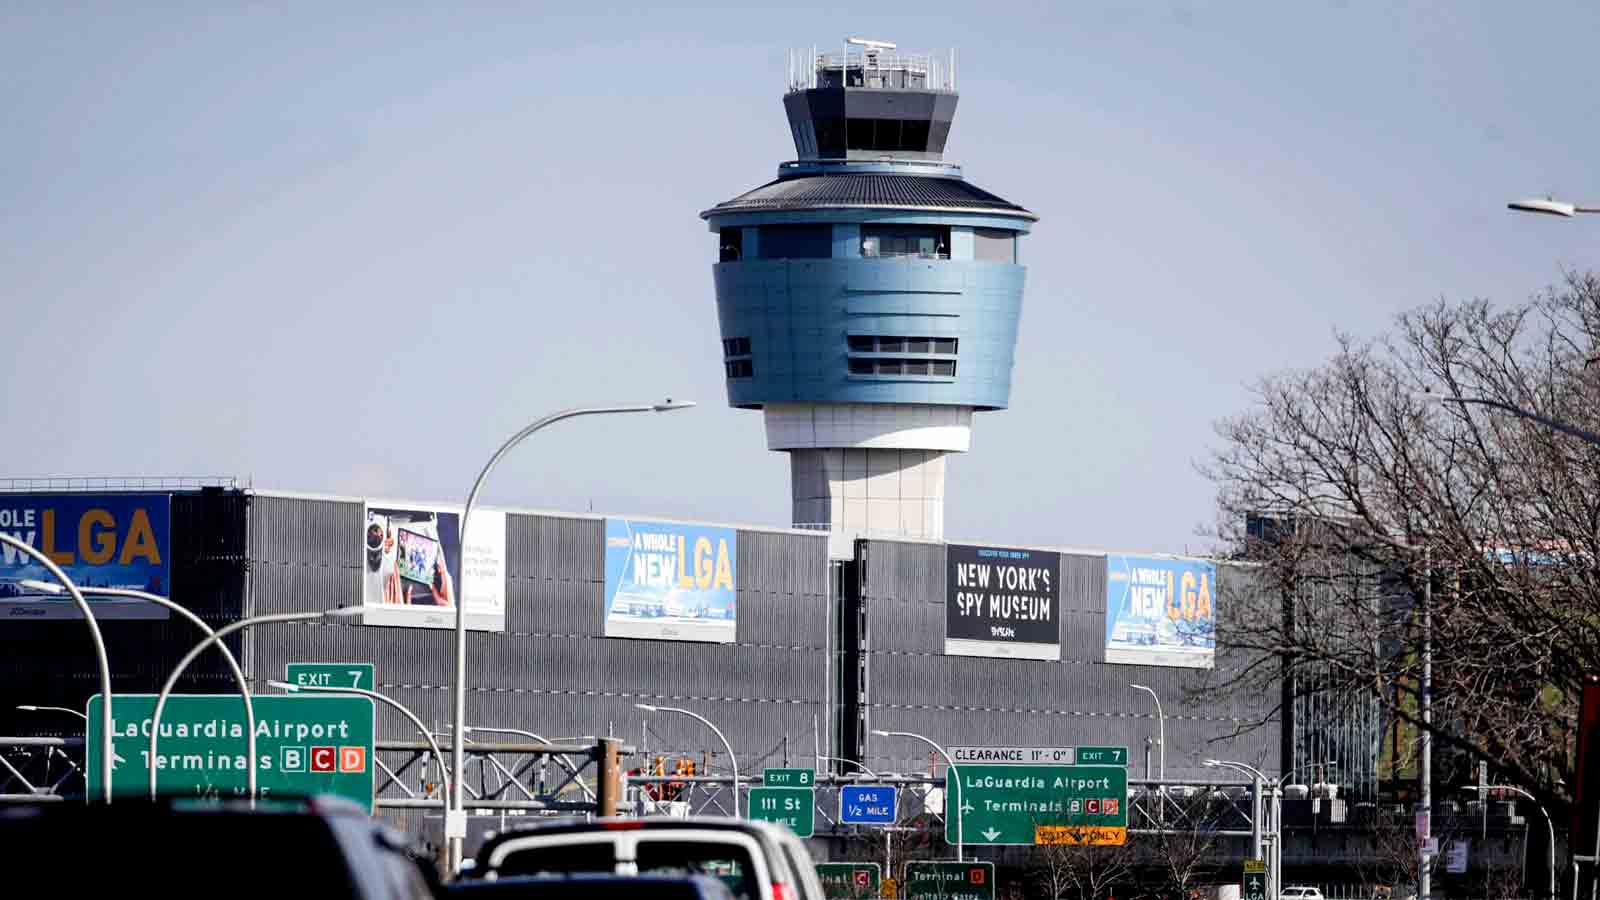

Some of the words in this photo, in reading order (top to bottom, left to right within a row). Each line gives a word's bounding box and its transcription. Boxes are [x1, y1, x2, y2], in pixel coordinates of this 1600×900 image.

[42, 507, 162, 566] LGA
[633, 553, 676, 585] NEW
[678, 535, 733, 592] LGA
[957, 563, 991, 588] NEW
[996, 565, 1050, 593] YORK'S
[1131, 586, 1167, 617] NEW
[1167, 570, 1212, 622] LGA
[957, 592, 984, 617] SPY
[990, 593, 1051, 621] MUSEUM
[298, 673, 331, 686] EXIT
[348, 671, 363, 688] 7
[112, 719, 242, 738] LaGuardia
[255, 719, 349, 741] Airport
[141, 751, 272, 769] Terminas
[285, 751, 301, 769] B
[315, 751, 330, 769] C
[344, 751, 360, 769] D
[955, 750, 1023, 761] CLEARANCE
[1083, 752, 1103, 760] EXIT
[1112, 751, 1121, 761] 7
[770, 774, 791, 783] EXIT
[800, 772, 809, 784] 8
[966, 776, 1045, 789] LaGuardia
[1053, 776, 1110, 790] Airport
[762, 798, 776, 810] 111
[784, 797, 801, 810] St
[858, 794, 878, 803] GAS
[849, 804, 862, 816] 1/2
[866, 807, 889, 816] MILE
[984, 800, 1062, 812] Terminals
[1070, 801, 1080, 812] B
[1087, 800, 1097, 812] C
[1089, 831, 1120, 842] ONLY
[913, 871, 965, 881] Terminal
[1245, 892, 1265, 900] LGA
